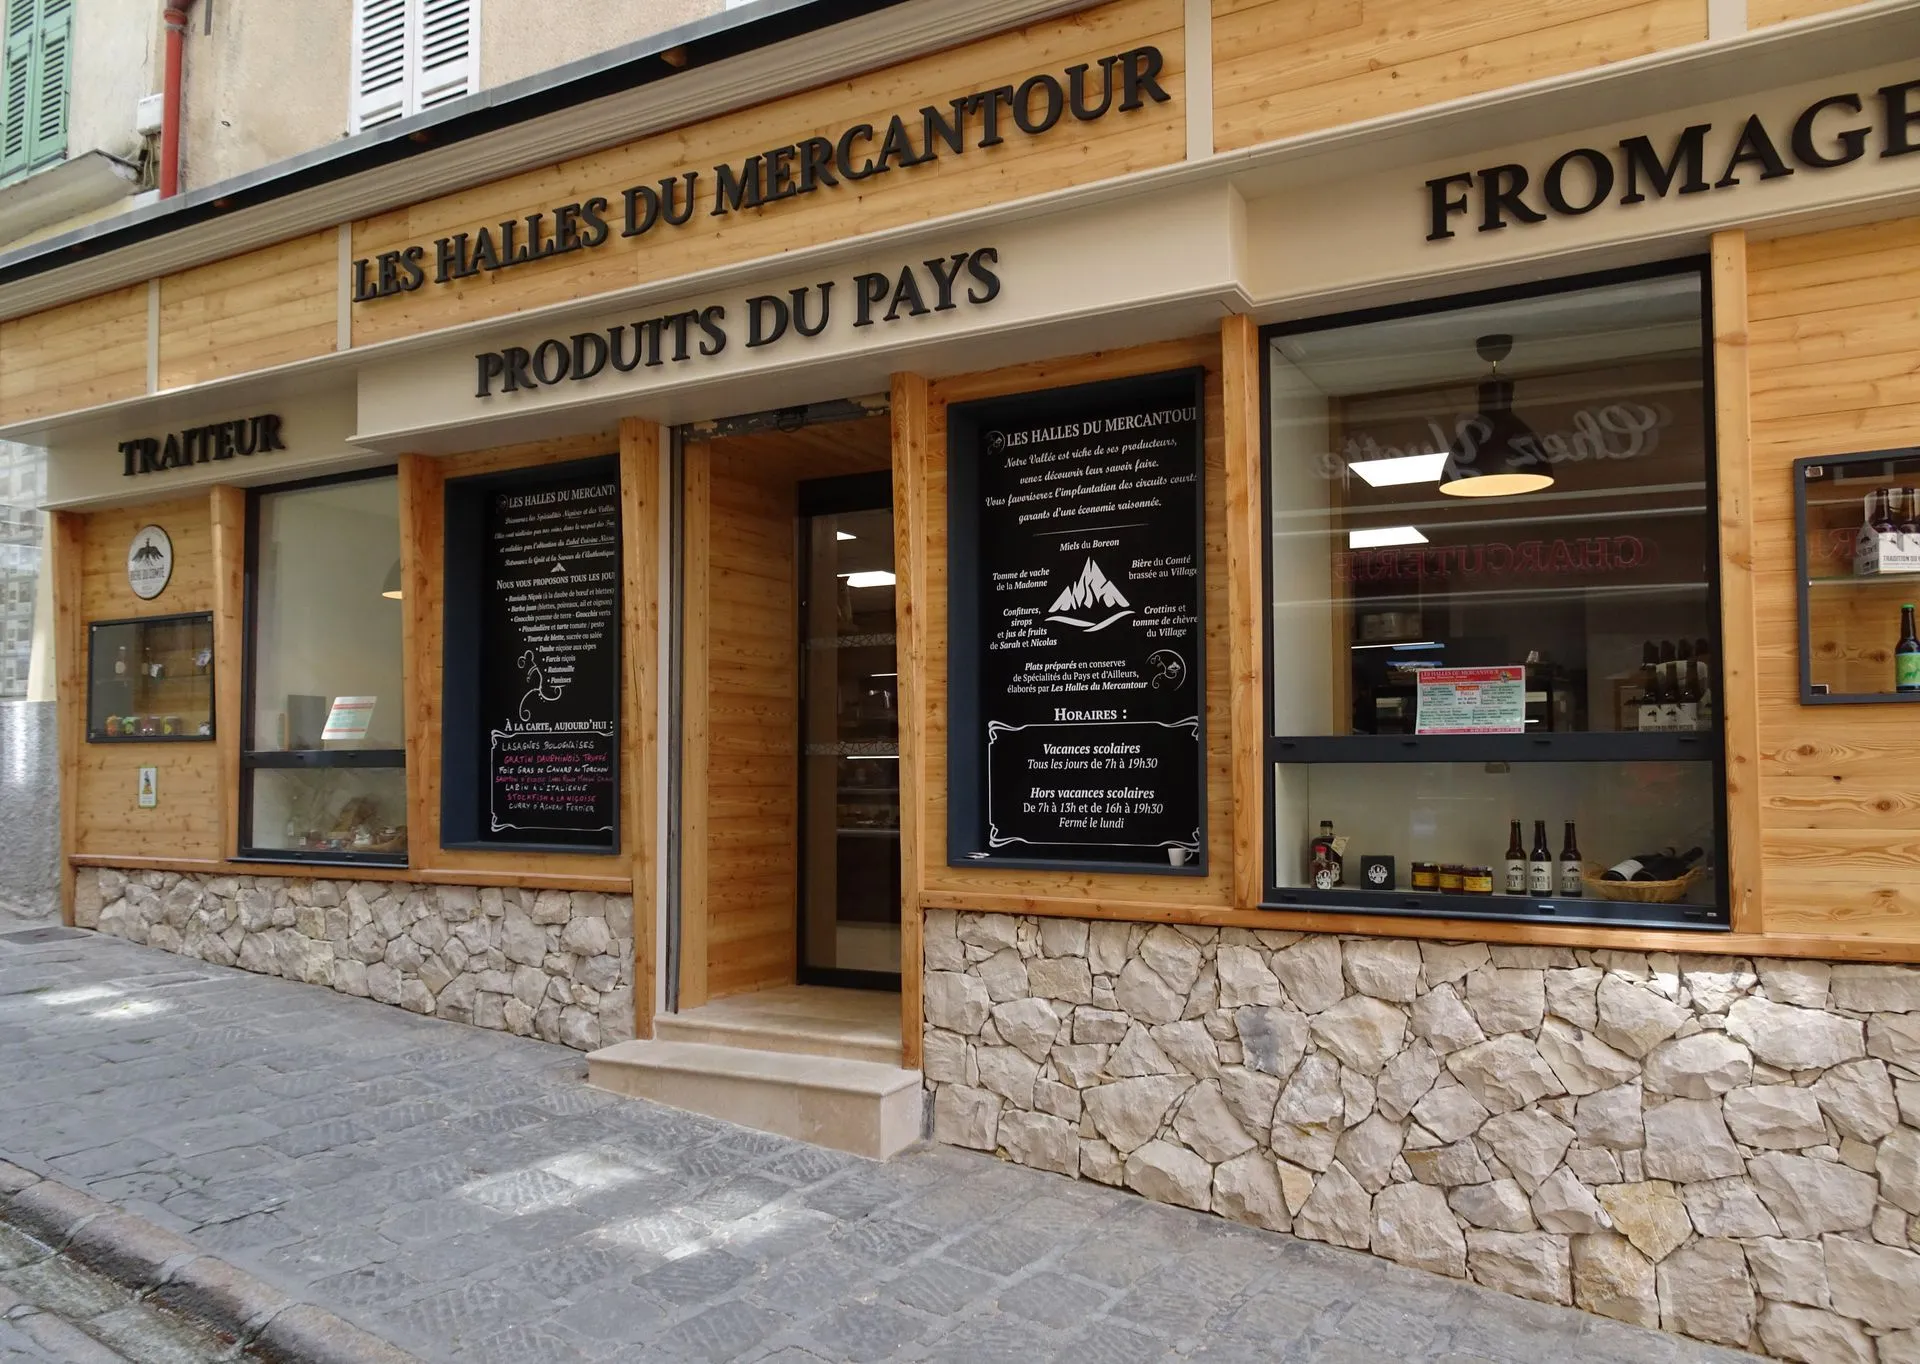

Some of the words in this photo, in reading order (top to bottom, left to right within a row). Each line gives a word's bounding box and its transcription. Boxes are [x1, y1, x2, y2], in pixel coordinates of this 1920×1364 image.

[353, 246, 424, 302] LES
[434, 197, 608, 284] HALLES
[621, 171, 698, 238] DU
[710, 45, 1171, 217] MERCANTOUR
[475, 305, 726, 398] PRODUITS
[745, 281, 836, 348] DU
[853, 247, 1001, 328] PAYS
[1007, 432, 1028, 446] LES
[1032, 424, 1079, 442] HALLES
[1083, 421, 1101, 435] DU
[118, 414, 285, 477] TRAITEUR
[1005, 458, 1026, 468] Notre
[1029, 453, 1055, 464] Vallée
[1058, 451, 1069, 460] est
[1072, 448, 1091, 458] riche
[1094, 445, 1104, 455] de
[1122, 440, 1176, 454] producteurs,
[1020, 476, 1042, 484] venez
[1045, 468, 1083, 480] découvrir
[1086, 466, 1103, 475] leur
[1106, 462, 1132, 473] savoir
[1135, 459, 1158, 472] faire.
[986, 497, 1005, 506] Vous
[1008, 492, 1053, 506] favoriserez
[1055, 483, 1116, 498] l'implantation
[1119, 480, 1132, 489] des
[1136, 477, 1167, 487] circuits
[509, 497, 523, 508] LES
[525, 492, 555, 506] HALLES
[558, 491, 569, 501] DU
[1019, 511, 1050, 524] garants
[1053, 507, 1075, 517] d'une
[1078, 502, 1115, 514] économie
[1118, 497, 1161, 510] raisonnée.
[1060, 542, 1079, 551] Miels
[1081, 541, 1090, 549] du
[1093, 540, 1119, 548] Boreon
[1132, 559, 1152, 568] Bière
[1154, 558, 1163, 566] du
[1166, 555, 1190, 565] Comté
[1020, 570, 1028, 578] de
[1030, 568, 1049, 576] vache
[1129, 570, 1157, 579] brassée
[997, 583, 1005, 591] de
[1007, 582, 1015, 590] la
[1014, 580, 1047, 589] Madonne
[1003, 607, 1040, 616] Confitures,
[1144, 605, 1176, 614] Crottins
[1011, 619, 1032, 627] sirops
[1161, 616, 1170, 624] de
[1006, 630, 1016, 639] jus
[1018, 629, 1026, 637] de
[1028, 628, 1048, 636] fruits
[1147, 629, 1156, 637] du
[1159, 628, 1186, 637] Village
[1000, 640, 1020, 649] Sarah
[1031, 638, 1057, 646] Nicolas
[1045, 661, 1077, 671] préparés
[1089, 660, 1125, 668] conserves
[1013, 674, 1021, 682] de
[1023, 671, 1060, 683] Spécialités
[1062, 672, 1071, 680] du
[1074, 672, 1090, 681] Pays
[1101, 670, 1139, 678] d'Ailleurs,
[1007, 684, 1036, 693] élaborés
[1038, 686, 1049, 694] par
[1051, 684, 1063, 692] Les
[1065, 683, 1088, 691] Halles
[1090, 682, 1100, 690] du
[1102, 682, 1148, 690] Mercantour
[1044, 744, 1090, 754] Vacances
[1093, 743, 1140, 754] scolaires
[1028, 759, 1048, 769] Tous
[1051, 759, 1063, 769] les
[1064, 759, 1088, 769] jours
[1091, 758, 1102, 768] de
[1105, 758, 1116, 768] 7h
[1119, 758, 1124, 768] à
[1129, 758, 1157, 768] 19h30
[1031, 788, 1055, 798] Hors
[1058, 790, 1104, 798] vacances
[1107, 787, 1154, 798] scolaires
[1024, 803, 1035, 812] De
[1039, 802, 1049, 812] 7h
[1052, 802, 1057, 812] à
[1061, 802, 1076, 812] 13h
[1079, 804, 1088, 812] et
[1091, 803, 1102, 813] de
[1106, 803, 1121, 813] 16h
[1125, 803, 1130, 813] à
[1134, 803, 1163, 814] 19h30
[1059, 817, 1087, 827] Fermé
[1090, 817, 1097, 827] le
[1100, 818, 1124, 828] lundi
